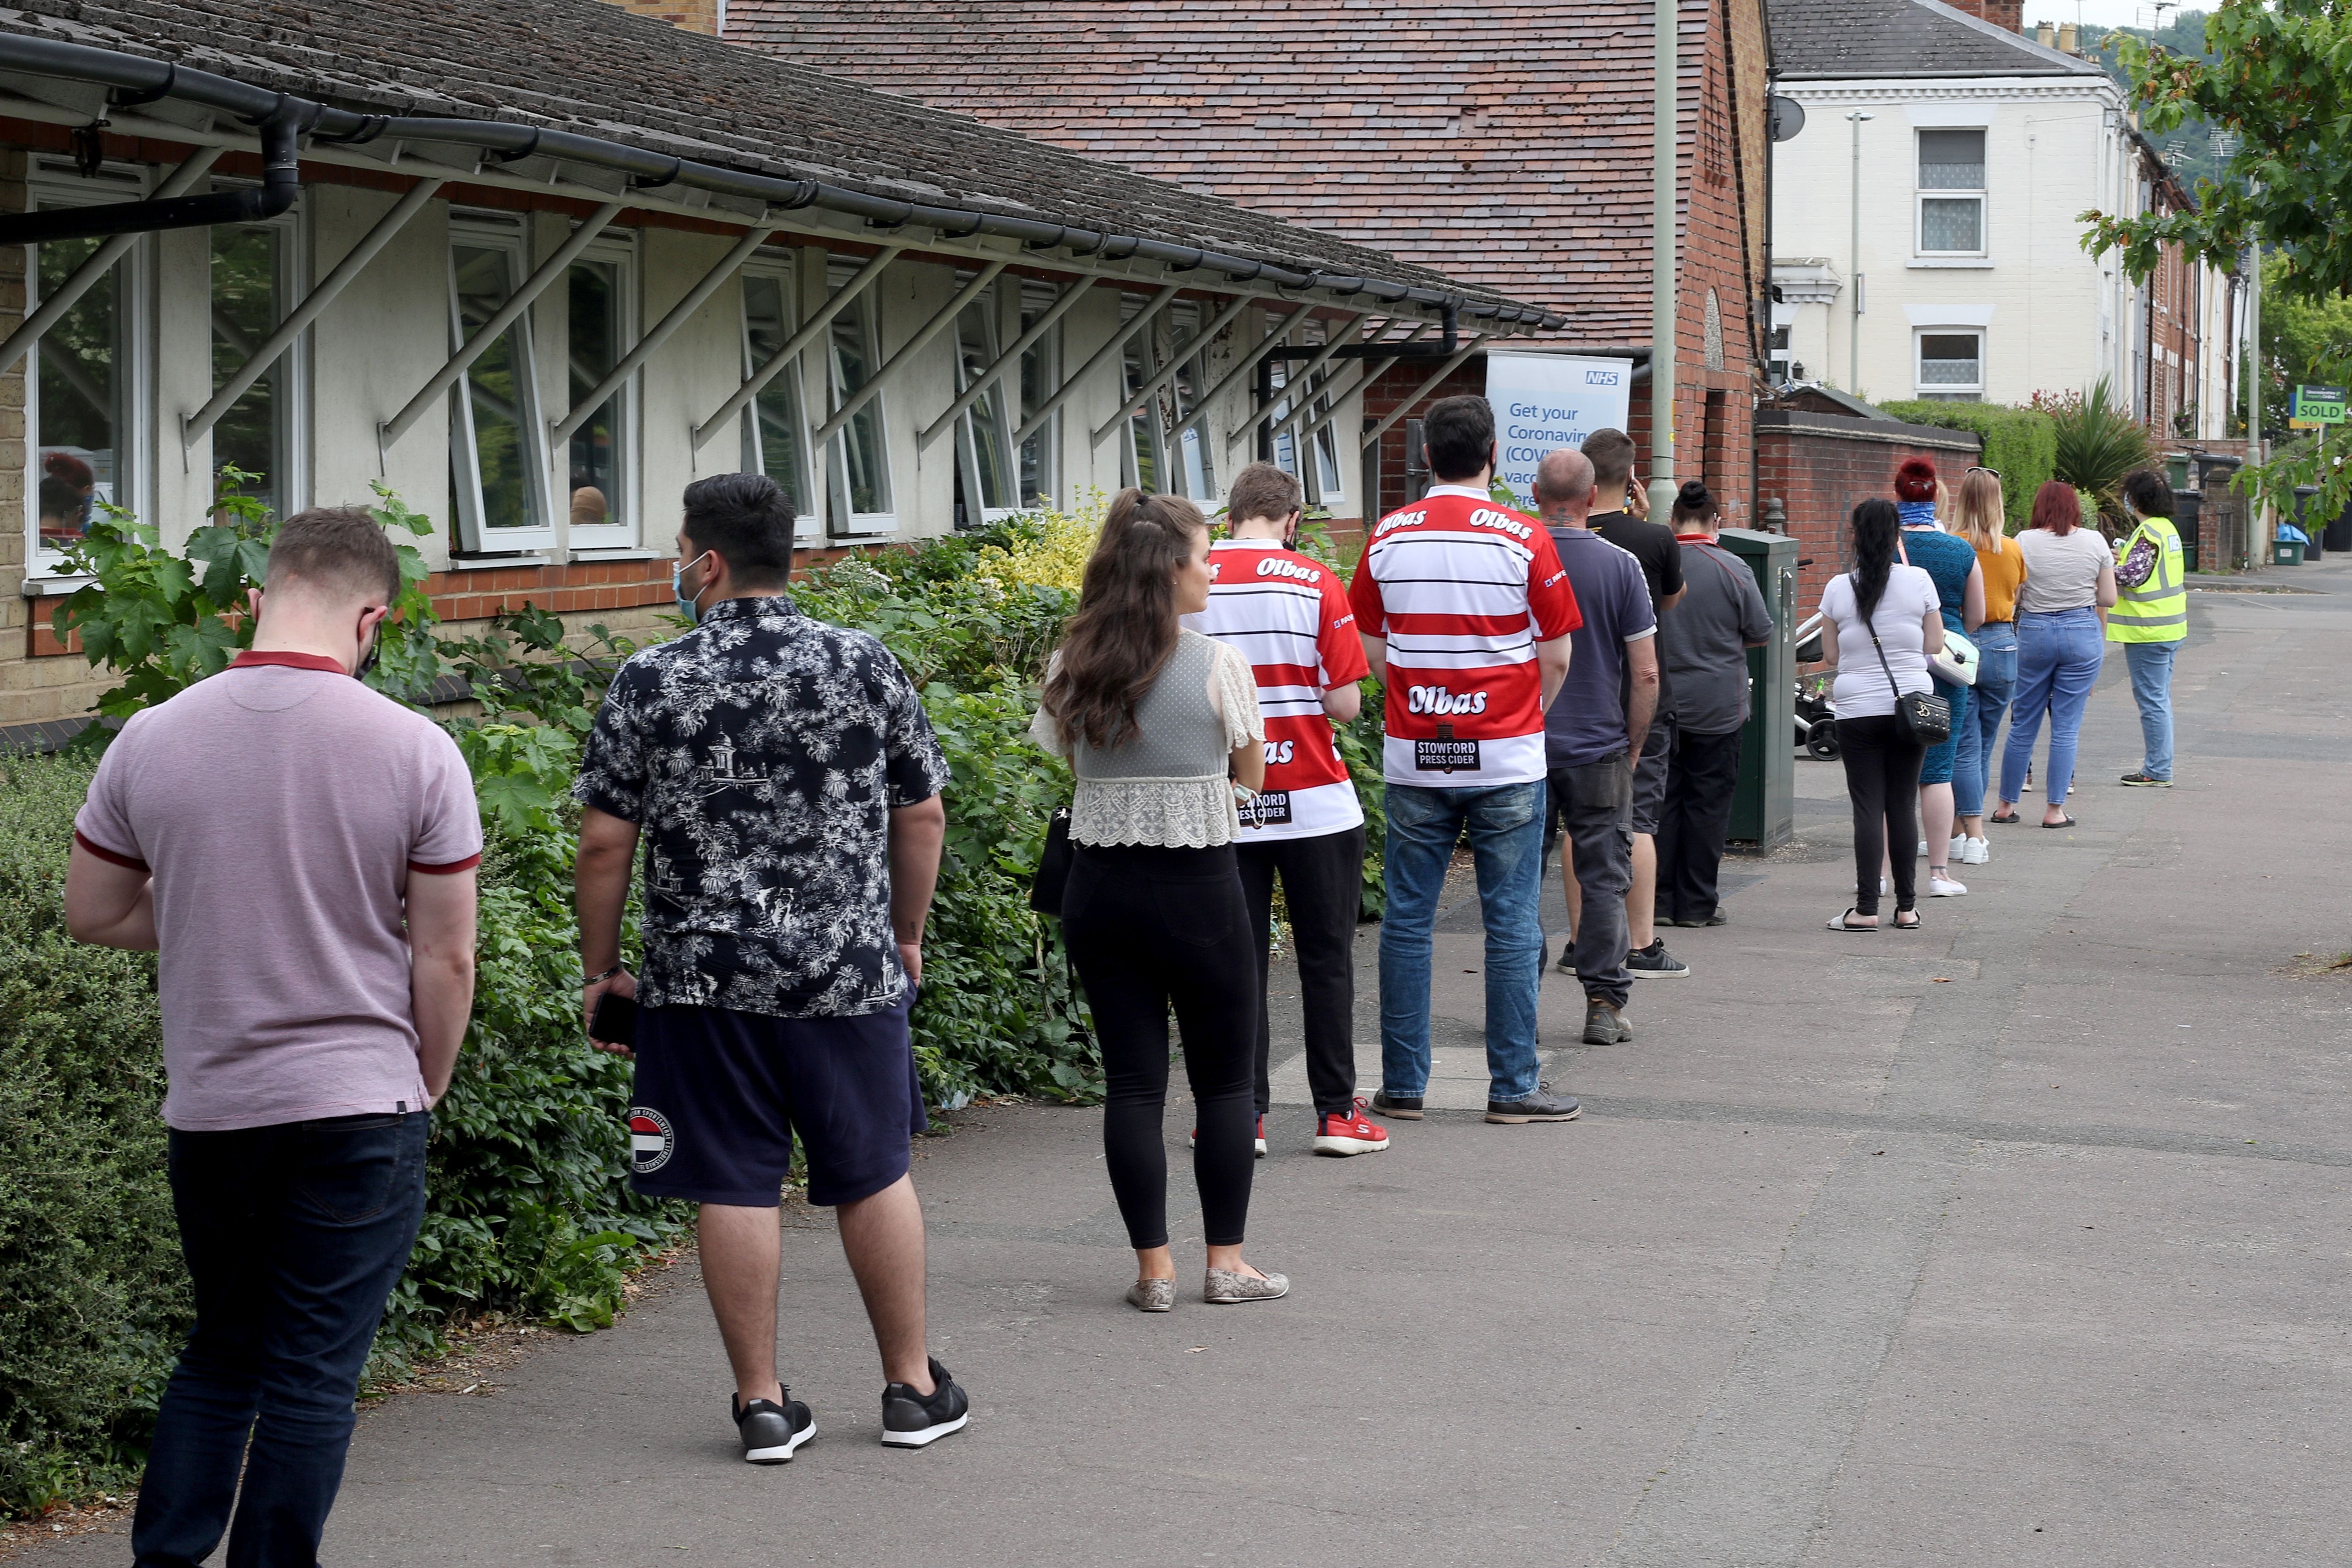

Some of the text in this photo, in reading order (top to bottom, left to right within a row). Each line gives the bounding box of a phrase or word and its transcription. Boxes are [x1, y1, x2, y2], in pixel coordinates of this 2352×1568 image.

[1586, 372, 1618, 385] NHS
[1510, 403, 1578, 422] Get your
[2300, 405, 2340, 417] SOLD
[1508, 425, 1586, 443] Coronavir
[1506, 446, 1551, 462] (COV
[1504, 472, 1536, 483] vacc
[1374, 510, 1427, 537] Olbas
[1469, 508, 1533, 540] Olbas
[1256, 557, 1321, 584] Olbas
[1340, 614, 1354, 625] PAV
[1408, 685, 1488, 715] Olbas
[1418, 742, 1476, 754] STOWFORD
[1420, 755, 1474, 764] PRESS CIDER
